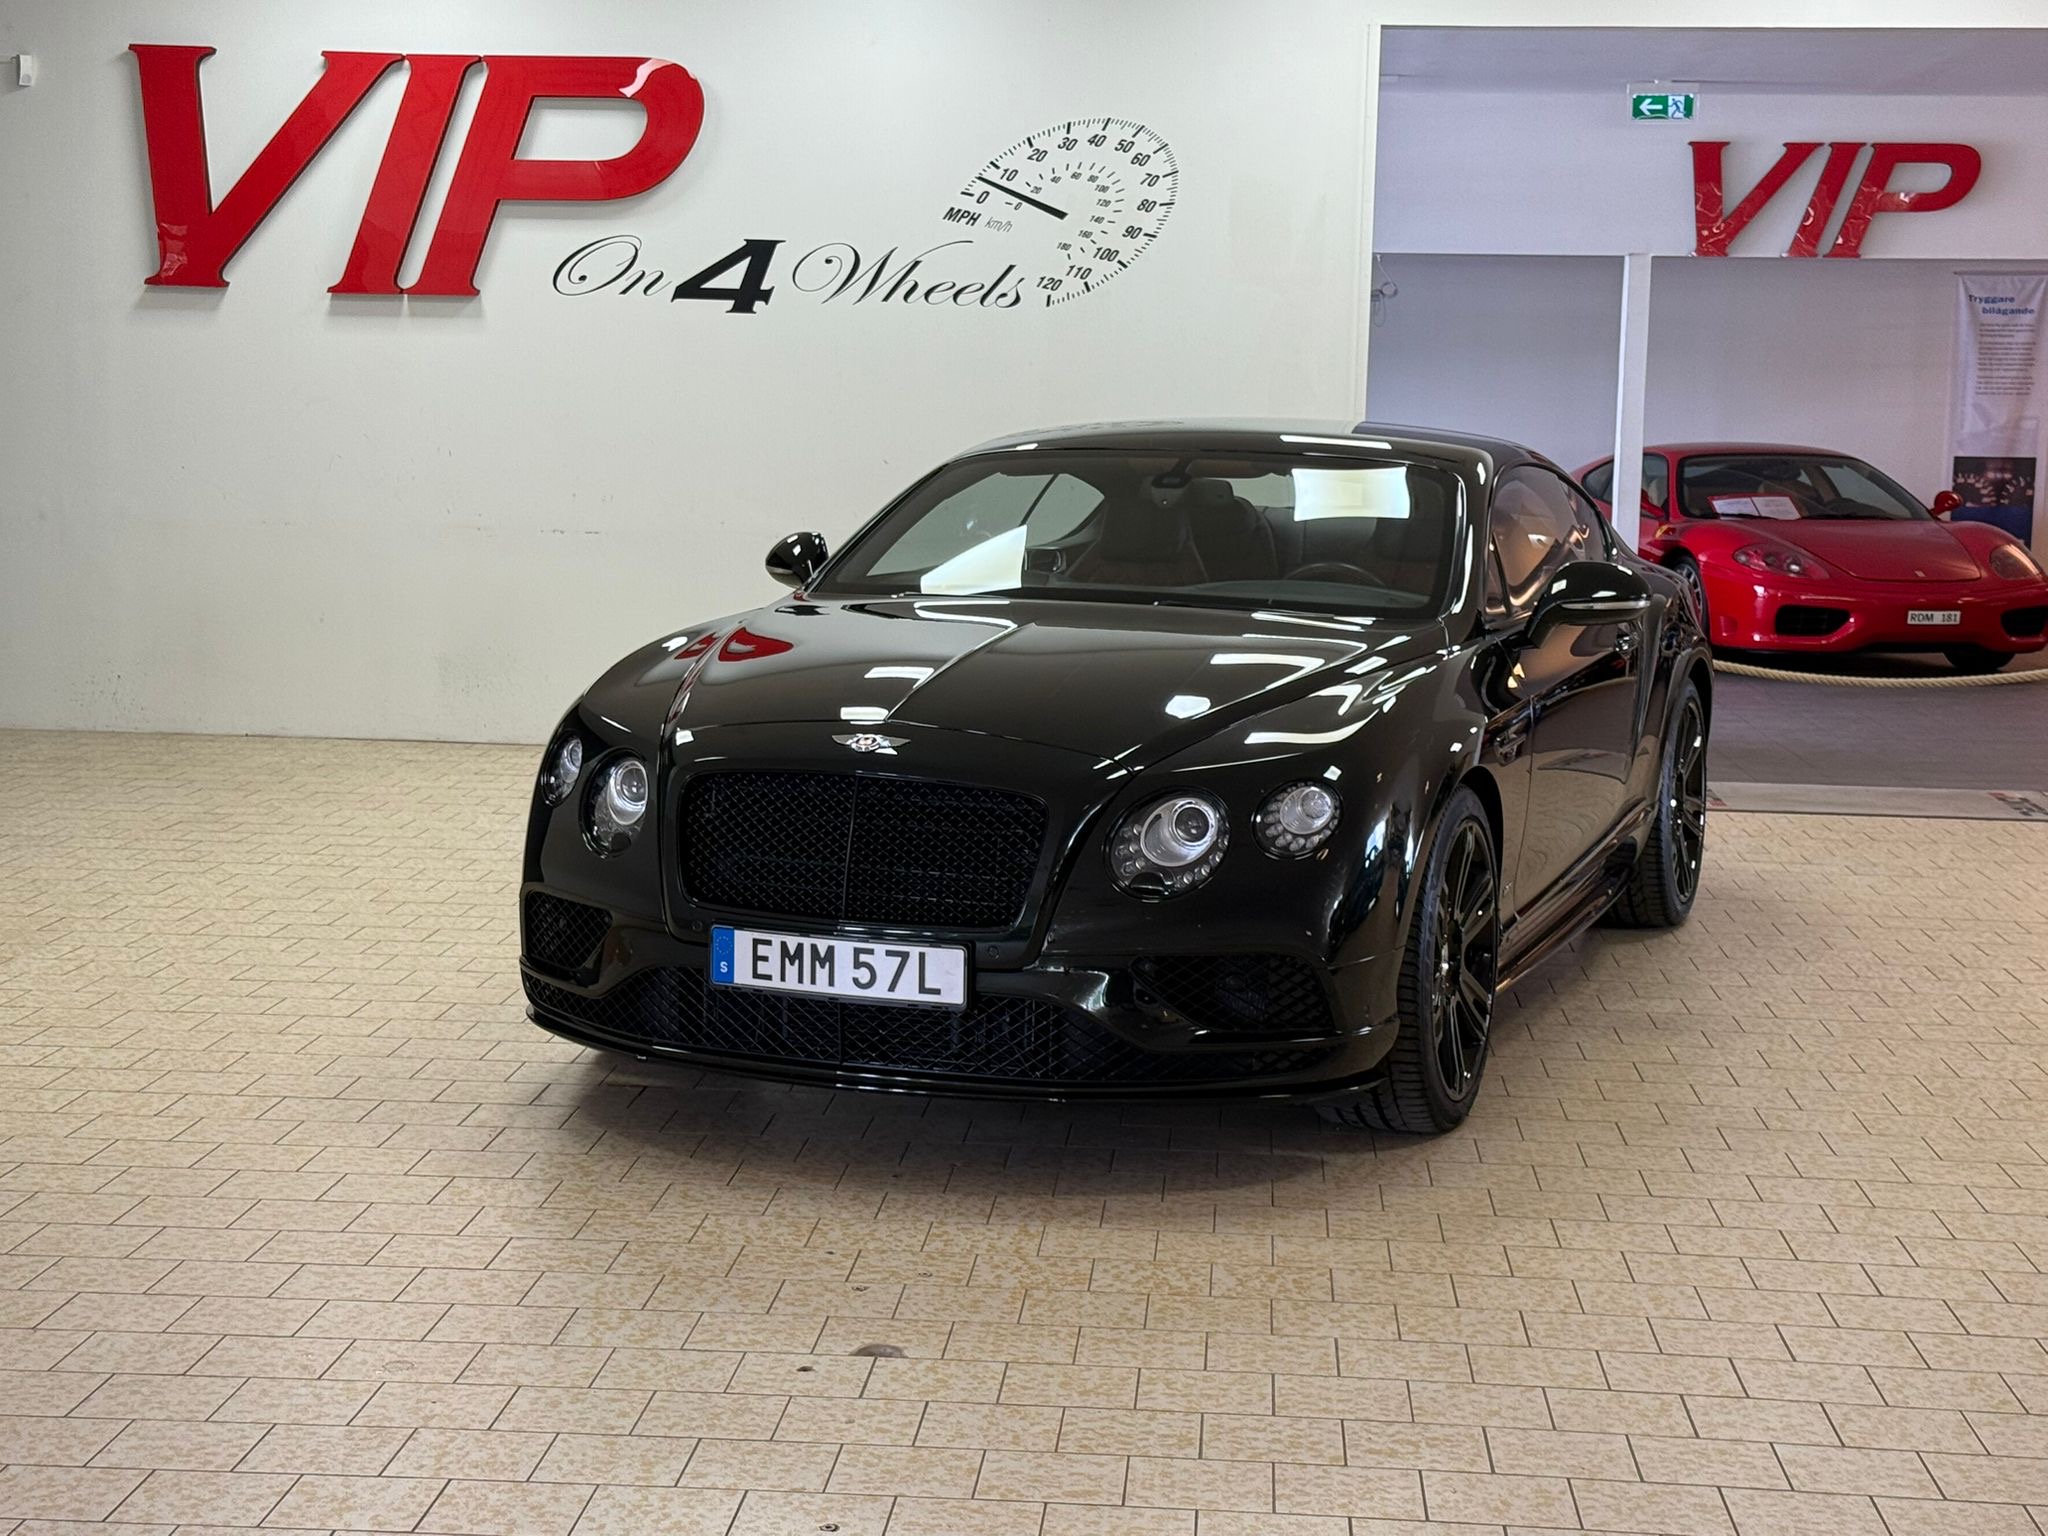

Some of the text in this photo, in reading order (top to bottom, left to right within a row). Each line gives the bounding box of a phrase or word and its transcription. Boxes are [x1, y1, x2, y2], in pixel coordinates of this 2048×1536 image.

[1057, 136, 1079, 151] 30
[1087, 134, 1107, 148] 40
[1114, 139, 1135, 154] 50
[1027, 147, 1049, 163] 20
[1130, 152, 1151, 168] 60
[129, 44, 705, 296] VIP
[999, 168, 1019, 182] 10
[1050, 176, 1062, 184] 40
[1139, 173, 1160, 187] 70
[1094, 184, 1110, 193] 100
[976, 190, 990, 204] 0
[1096, 199, 1112, 208] 120
[1687, 141, 1982, 258] VIP
[1014, 202, 1023, 211] 0
[1136, 199, 1157, 213] 80
[942, 206, 1013, 233] MPH km/h
[1089, 215, 1105, 224] 140
[1121, 225, 1142, 240] 90
[1092, 247, 1120, 262] 100
[552, 235, 1025, 314] On 4 Wheels
[1065, 265, 1092, 281] 110
[1036, 276, 1063, 292] 120
[1968, 294, 2015, 304] Tryggare
[719, 961, 728, 973] S
[752, 938, 941, 995] EMM 57L
